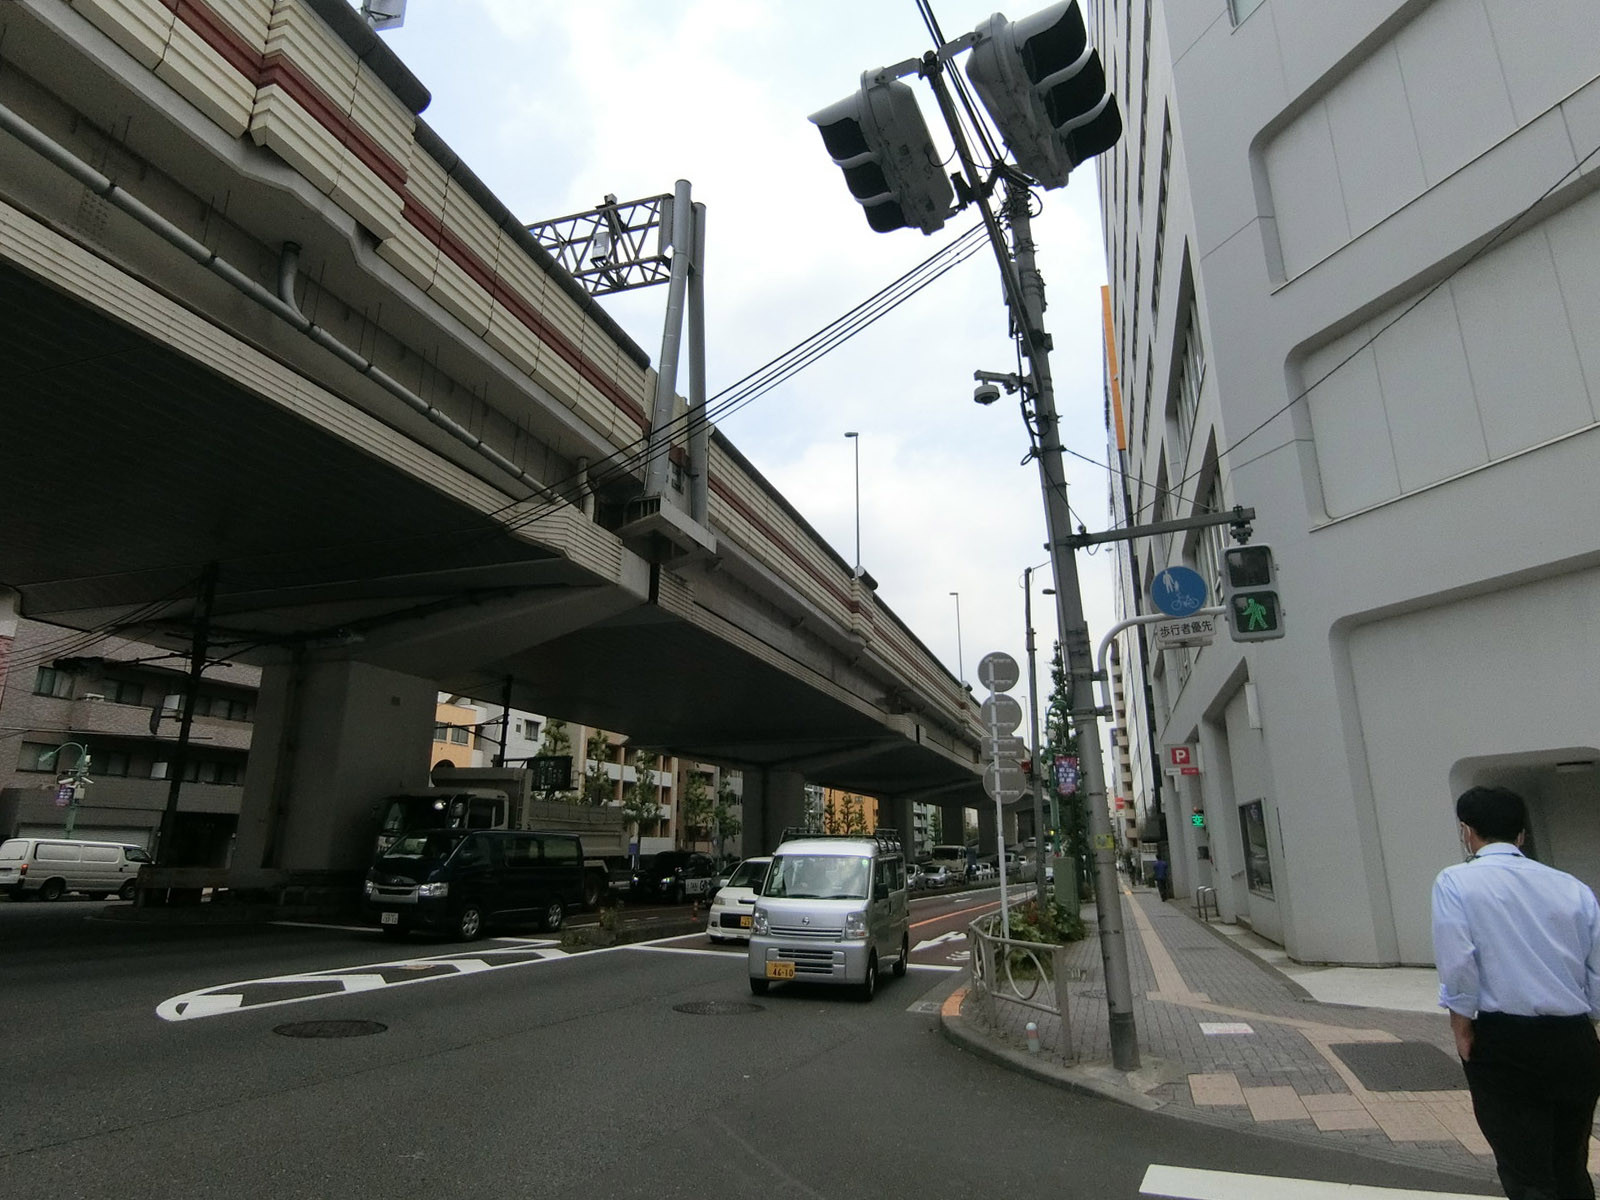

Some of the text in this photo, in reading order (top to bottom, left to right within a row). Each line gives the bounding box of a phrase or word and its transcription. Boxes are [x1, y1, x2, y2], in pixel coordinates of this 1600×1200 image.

[1160, 621, 1212, 638] 歩行者優先
[1175, 750, 1186, 763] P
